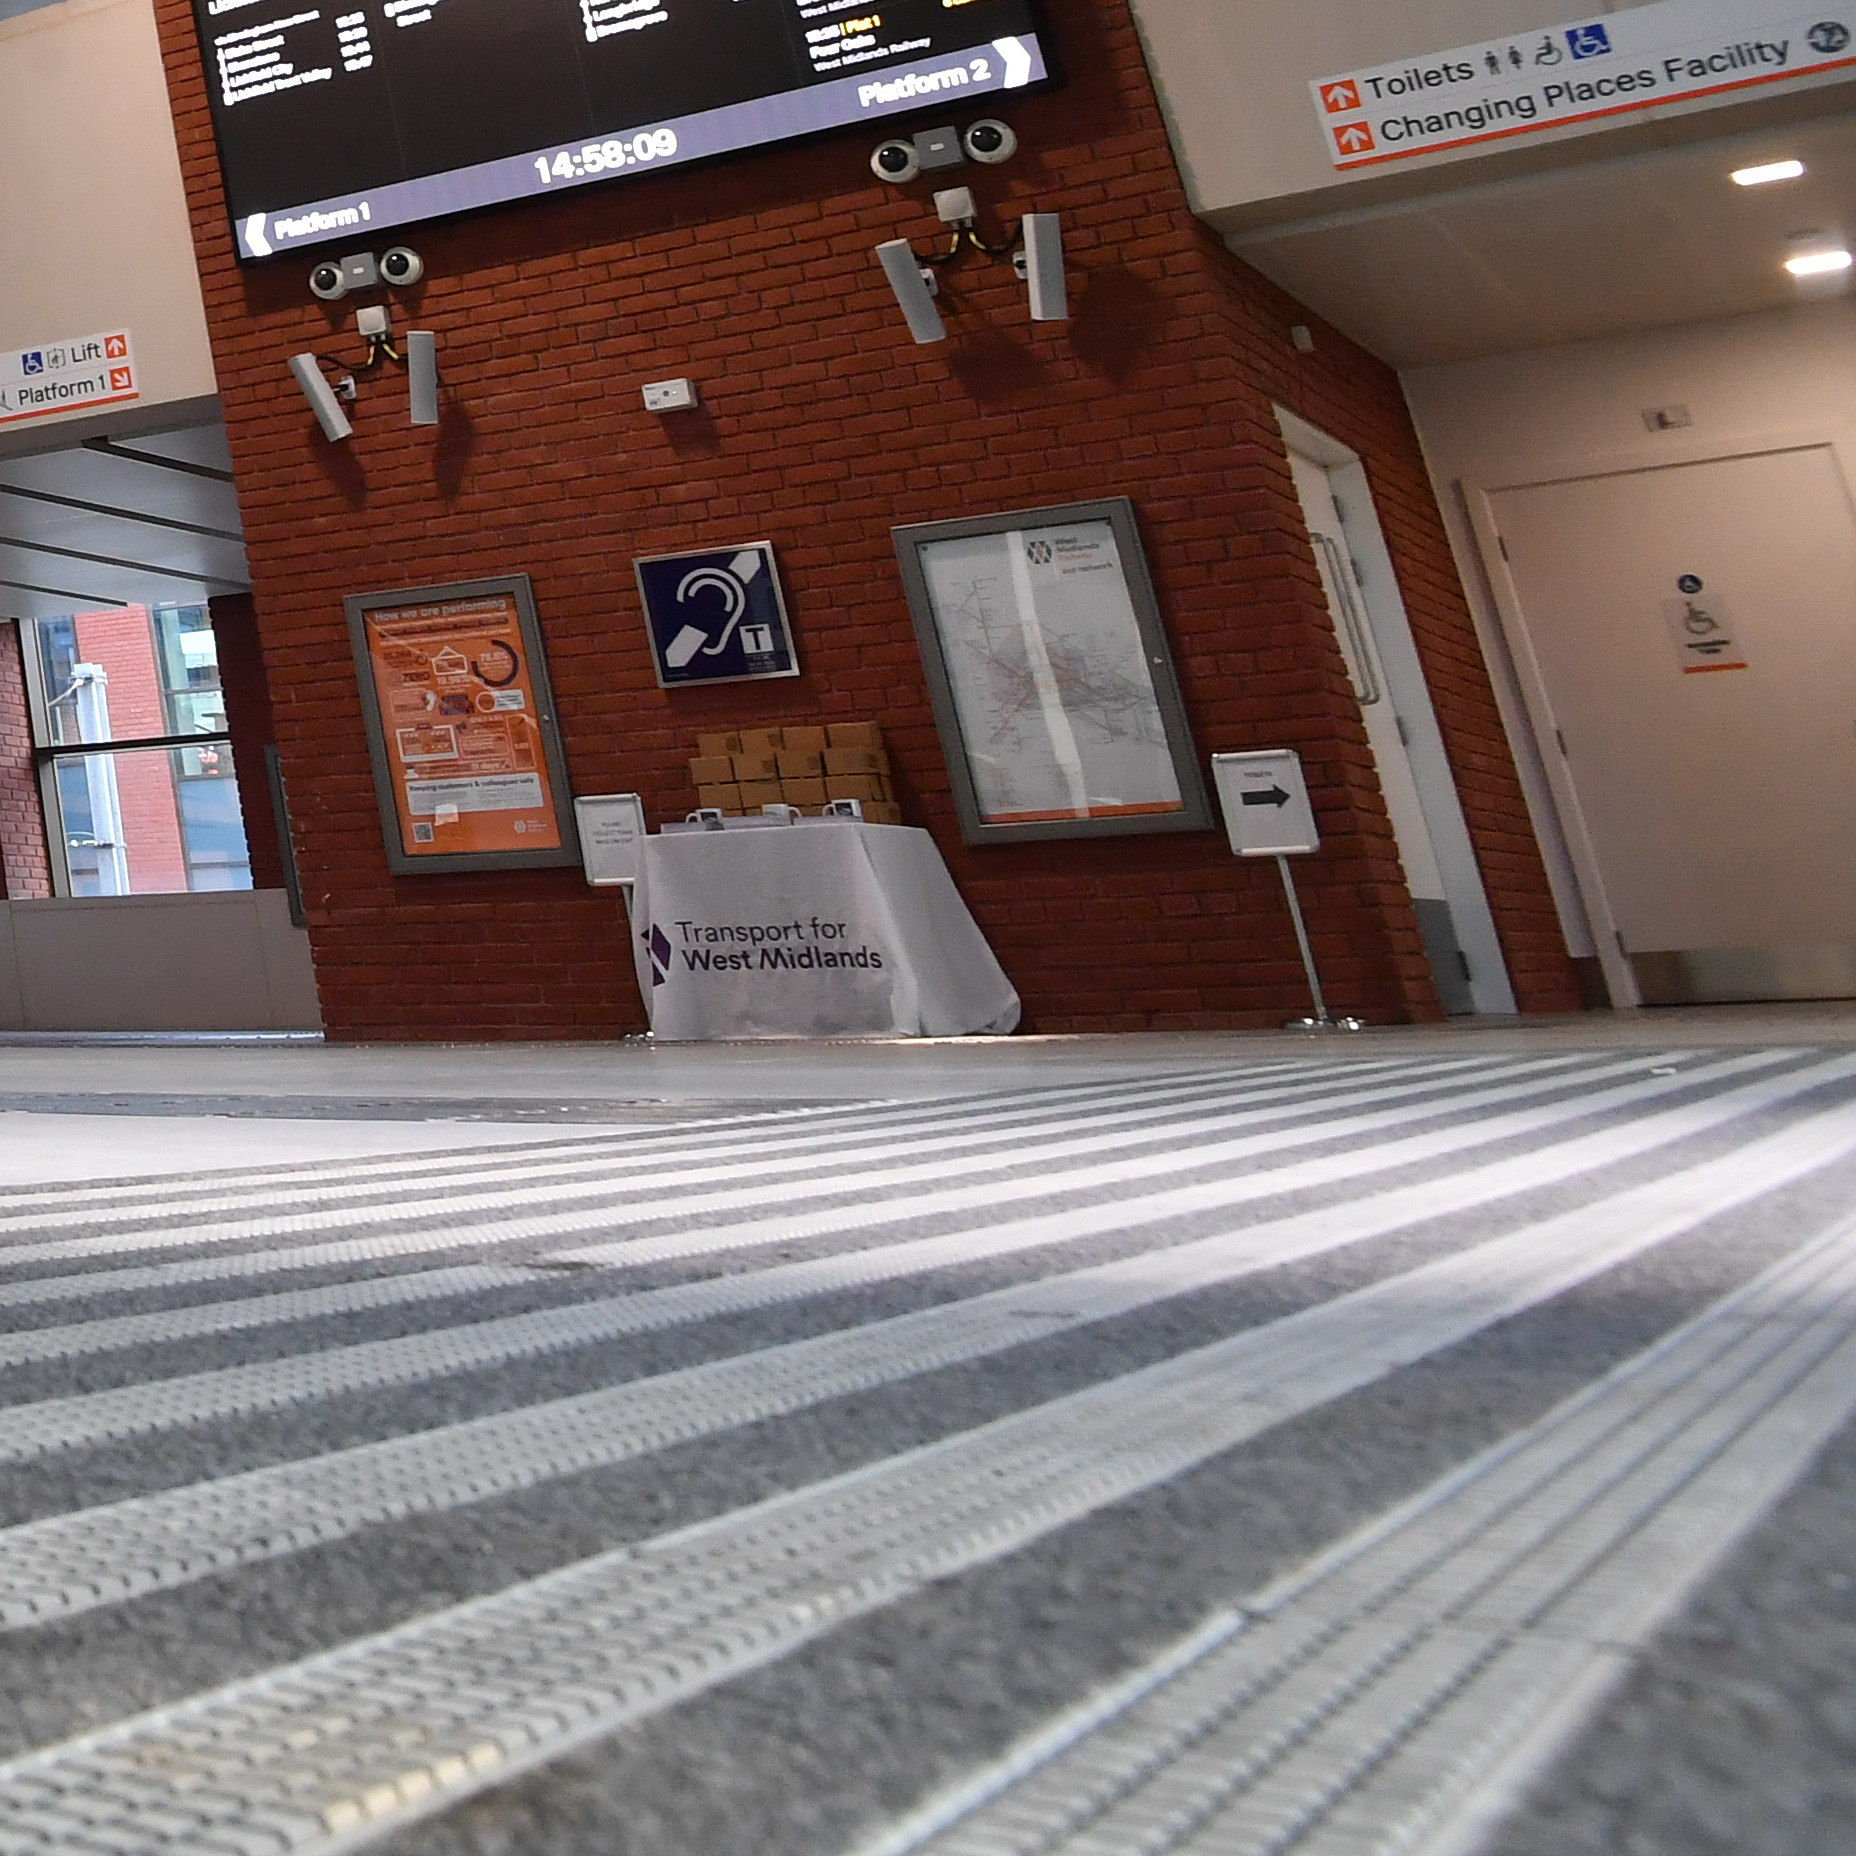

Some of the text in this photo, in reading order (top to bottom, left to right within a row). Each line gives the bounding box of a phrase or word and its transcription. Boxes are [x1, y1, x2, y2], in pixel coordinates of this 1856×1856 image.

[857, 58, 992, 107] Platform 2
[1364, 59, 1474, 101] Toilets
[1380, 38, 1790, 142] Changing Places Facility
[534, 128, 678, 184] 14:58:09
[274, 201, 371, 240] Platform 1
[71, 343, 102, 364] Lift
[18, 377, 95, 406] Platform
[98, 375, 107, 391] 1
[374, 598, 507, 623] How we are performing
[744, 626, 765, 651] T
[674, 917, 847, 947] Transport for
[681, 945, 883, 971] West Midlands
